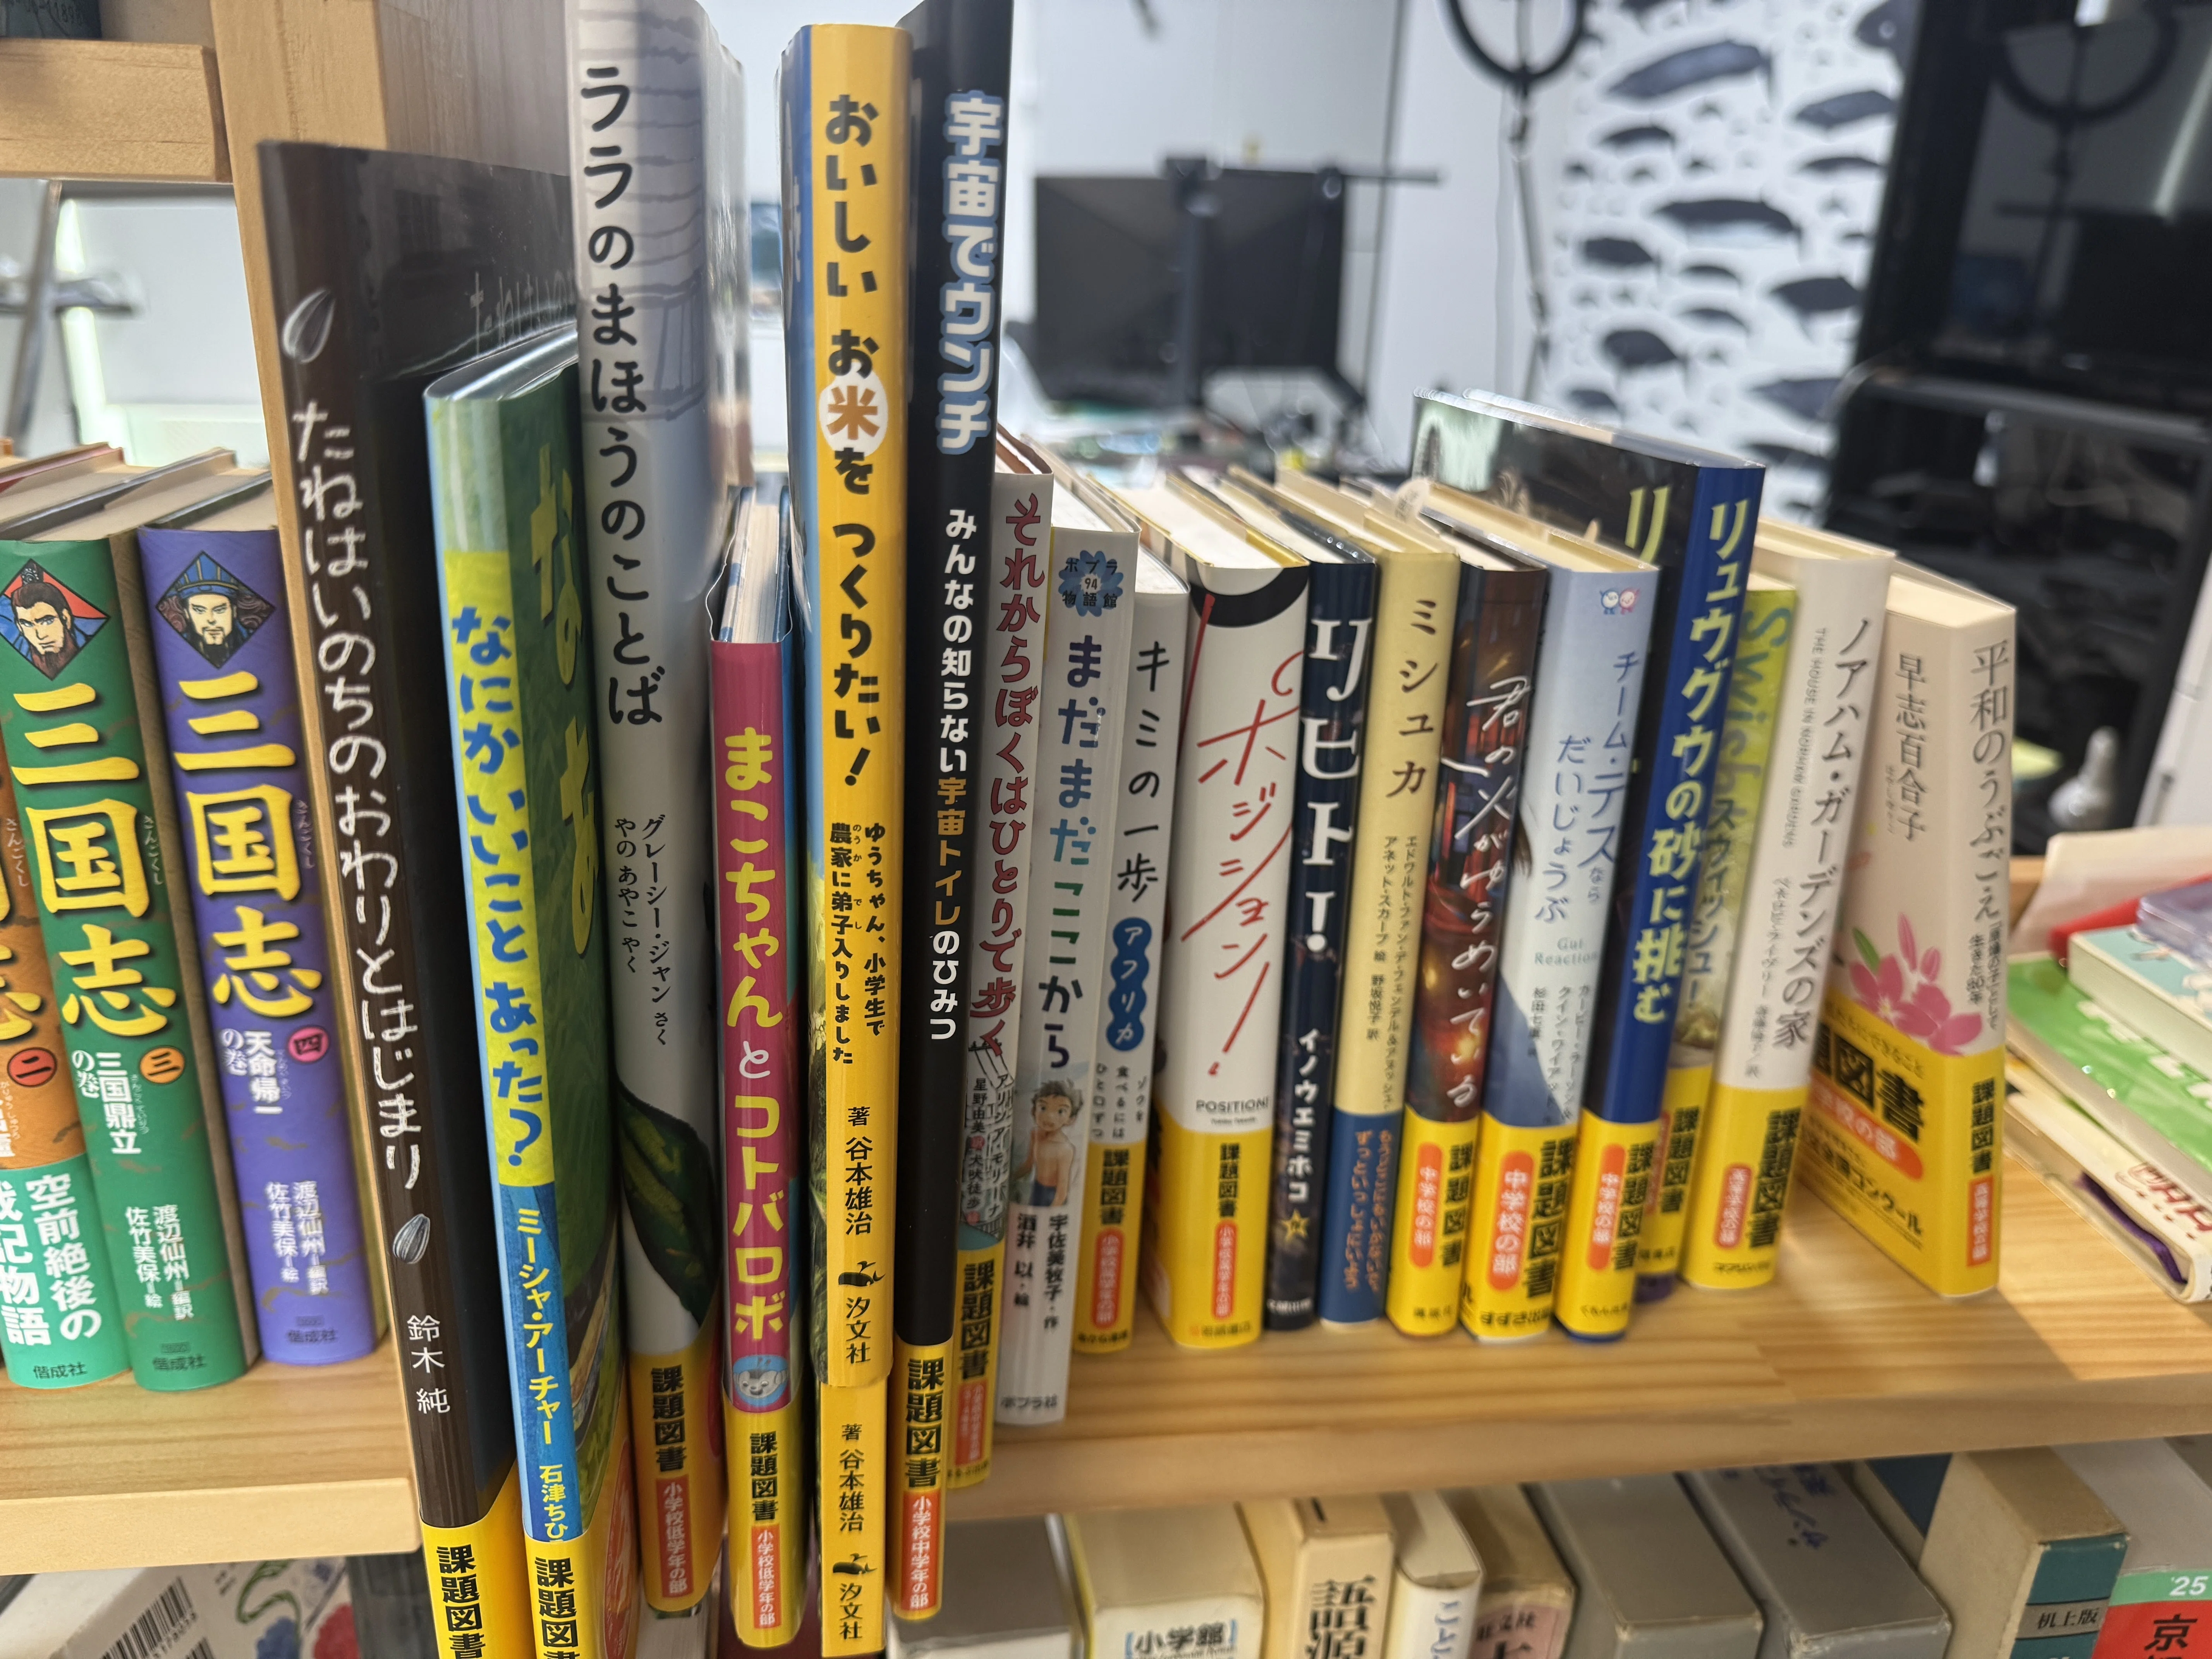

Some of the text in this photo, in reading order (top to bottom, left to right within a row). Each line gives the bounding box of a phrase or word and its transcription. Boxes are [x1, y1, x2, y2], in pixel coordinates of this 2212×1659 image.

[825, 94, 879, 297] おいしい
[939, 94, 1003, 452] 宇宙でウンチ
[582, 67, 665, 725] ララのまほうのことば
[826, 329, 881, 495] お米を
[1062, 592, 1118, 608] 物語館
[1065, 558, 1118, 574] ポプラ
[1084, 577, 1097, 590] 94
[1386, 599, 1438, 797] ミシュカ
[1895, 654, 1929, 842] 早志百合子
[293, 401, 421, 1189] たねはいのちのおわりとはじまり
[452, 607, 528, 963] なにかいいこと
[930, 509, 977, 1040] みんなの知らない宇宙トイレのひみつ
[970, 493, 1046, 1056] それからぼくはひとりで歩く
[1117, 641, 1170, 902] キミの一歩
[1632, 499, 1750, 1024] リュウグウの砂に挑む
[1970, 639, 2009, 922] 平和のうぶごえ
[6, 817, 27, 887] さんごくし
[12, 683, 176, 1036] 三国志
[143, 815, 163, 885] さんごくし
[173, 671, 322, 1017] 三国志
[1038, 635, 1106, 1068] まだまだここから
[1535, 735, 1591, 923] だいじょうぶ
[1774, 618, 1869, 1050] ノアハム・ガーデンズの家
[615, 818, 640, 973] やの あやこ やく
[642, 814, 672, 1045] グレーシー・ジャン さく
[830, 822, 853, 1064] 農家に弟子入りしました
[1441, 675, 1532, 1108] 君の火がゆらめいている
[294, 1034, 322, 1054] 四
[724, 727, 786, 1341] まこちゃんとコトバロボ
[1115, 926, 1143, 1044] アフリカ
[15, 1056, 52, 1079] 二
[72, 1049, 100, 1099] の巻
[96, 1051, 142, 1155] 三国鼎立
[149, 1051, 180, 1075] 三
[244, 1030, 283, 1115] 天命帰一
[970, 1077, 988, 1133] 星野由美
[1195, 1096, 1270, 1113] POSITION!
[1287, 1028, 1320, 1203] イノウエミホコ
[845, 1106, 873, 1235] 著 谷本雄治
[1218, 1143, 1241, 1218] 課題図書
[1661, 1106, 1700, 1214] 課題図書
[1746, 1106, 1802, 1249] 課題図書
[1970, 1077, 1996, 1174] 課題図書
[1101, 1149, 1130, 1224] 課題図書
[1442, 1140, 1474, 1268] 課題図書
[1491, 1168, 1528, 1278] 中学校の部
[1524, 1138, 1575, 1299] 課題図書
[1614, 1141, 1655, 1272] 課題図書
[26, 1173, 102, 1341] 空前絶後の
[33, 1362, 88, 1379] 偕成社
[407, 1315, 450, 1414] 鈴木 純
[517, 1207, 559, 1444] ミーシャ・アーチャー
[845, 1297, 871, 1364] 汐文社
[960, 1259, 994, 1381] 課題図書
[651, 1364, 687, 1472] 課題図書
[749, 1431, 778, 1521] 課題図書
[905, 1357, 945, 1488] 課題図書
[539, 1464, 568, 1543] 石津ちひ
[839, 1423, 865, 1533] 著 谷本雄治
[664, 1482, 688, 1594] 小学校低学年の部
[756, 1529, 775, 1626] 小学校低学年の部
[910, 1495, 931, 1609] 小学校中学年の部
[436, 1544, 486, 1659] 課題図書
[534, 1557, 580, 1659] 課題図
[839, 1582, 863, 1640] 汐文社
[2037, 1607, 2099, 1630] 机上版
[2144, 1613, 2198, 1659] 京
